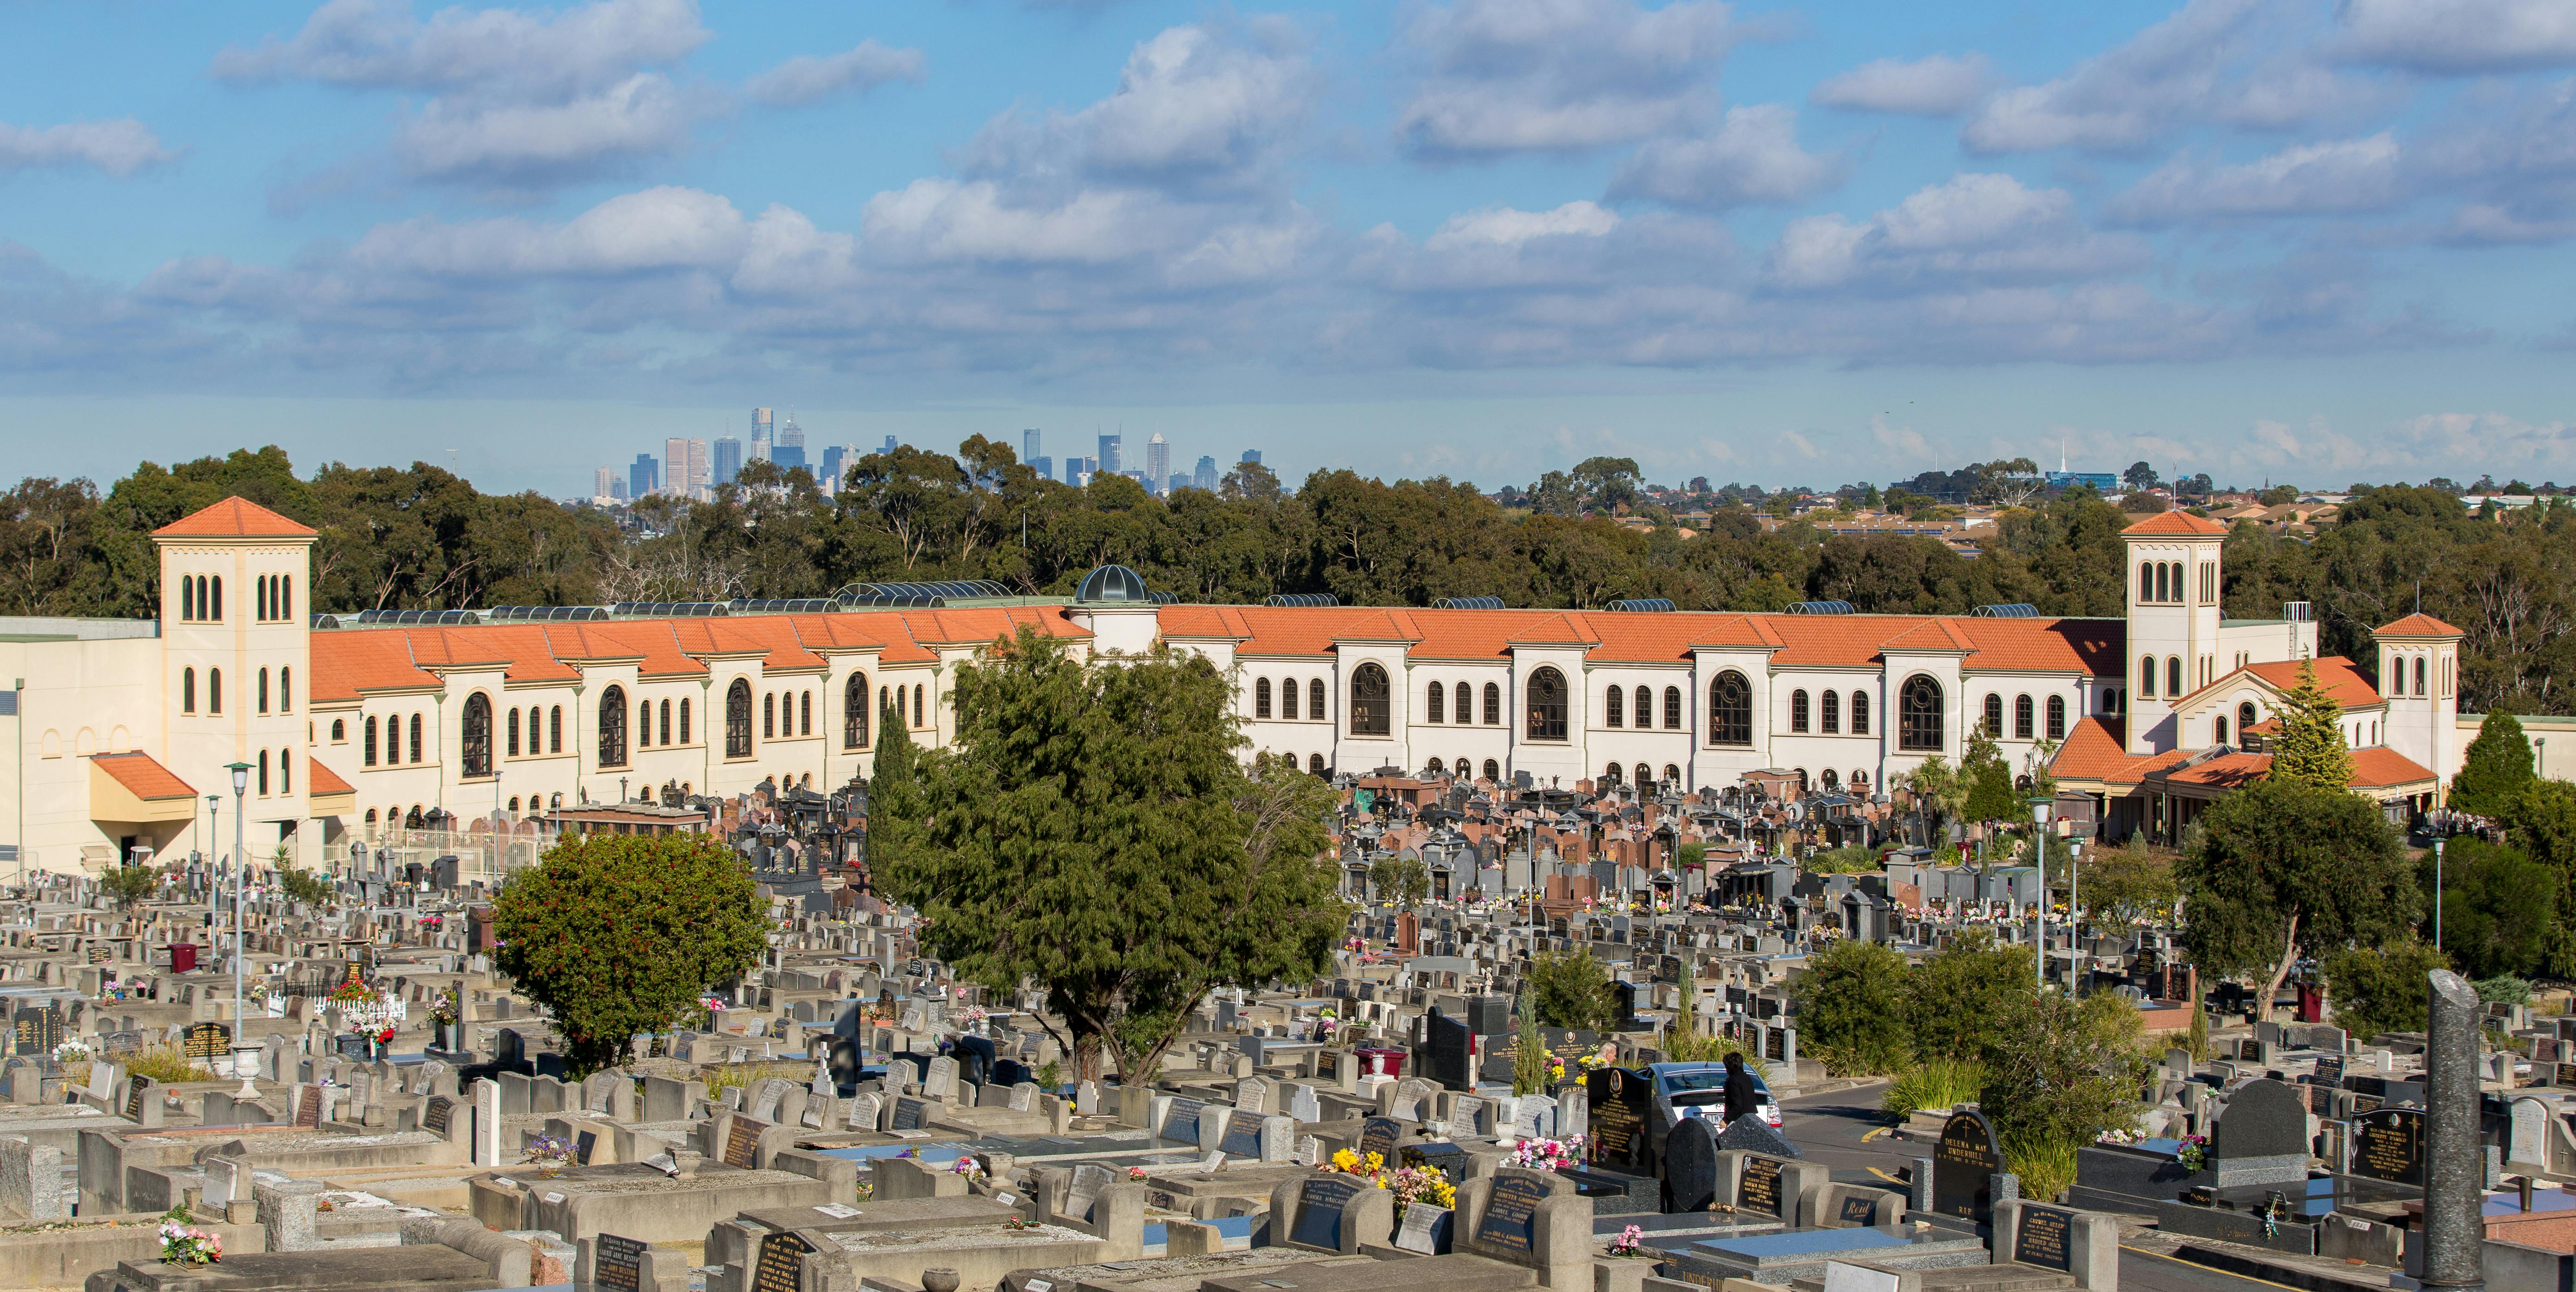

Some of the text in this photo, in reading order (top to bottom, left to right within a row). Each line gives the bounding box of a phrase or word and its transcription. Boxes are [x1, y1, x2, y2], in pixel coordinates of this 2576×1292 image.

[1951, 1115, 1965, 1126] LOVING
[1966, 1116, 1981, 1128] MEMORY
[1948, 1147, 1983, 1160] UNDERHILL
[1975, 1144, 1986, 1152] MAY
[1496, 1191, 1539, 1205] ANNETTA GOODWIN
[1492, 1207, 1508, 1215] LIONEL
[1846, 1202, 1871, 1214] Reid
[1506, 1233, 1527, 1244] GOODWIN
[765, 1243, 781, 1251] GEORGE
[599, 1249, 611, 1257] SARAH
[613, 1252, 622, 1260] JANE
[608, 1264, 618, 1272] JOHN
[759, 1279, 774, 1288] THELMA
